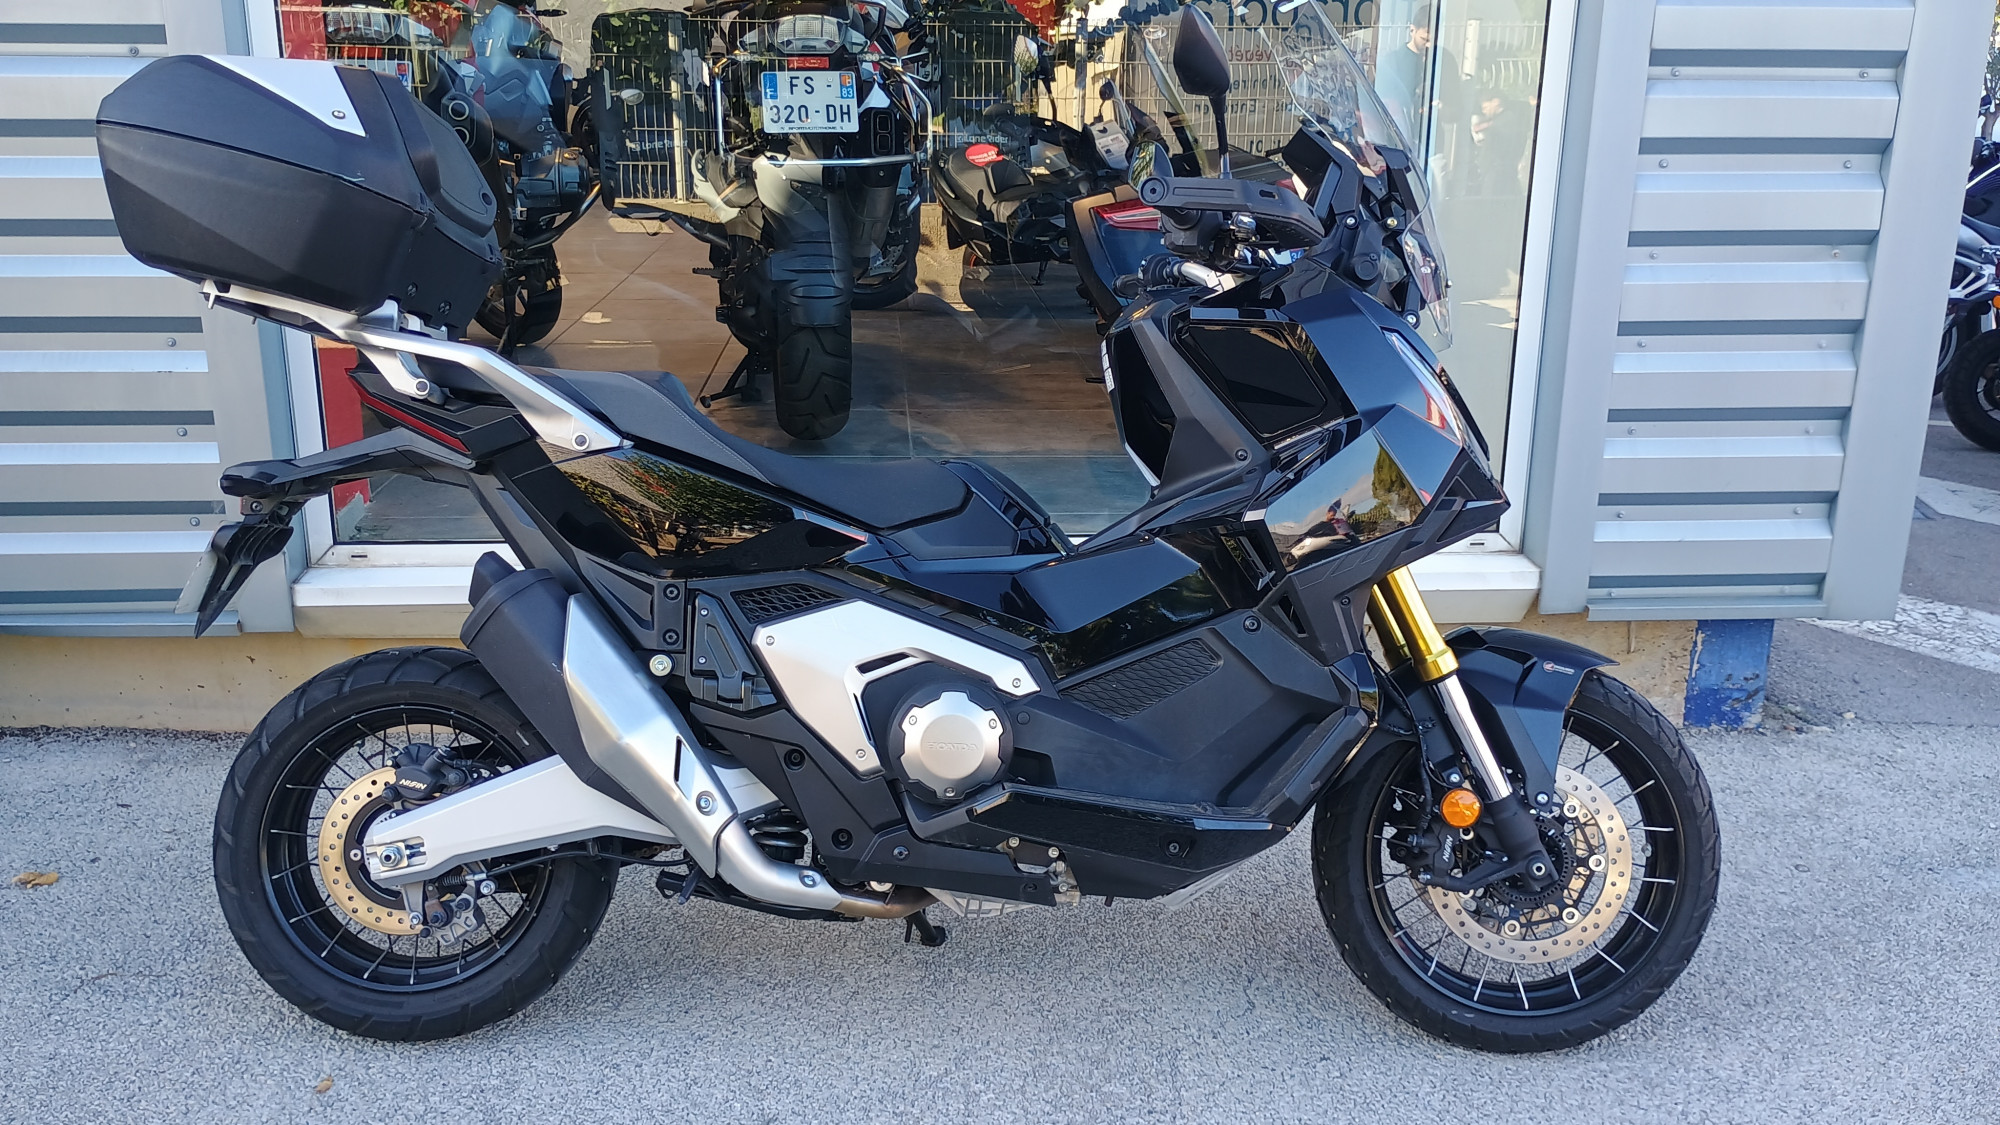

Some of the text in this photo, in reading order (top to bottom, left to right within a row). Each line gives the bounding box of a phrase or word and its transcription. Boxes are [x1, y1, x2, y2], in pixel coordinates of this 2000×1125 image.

[789, 76, 815, 95] FS
[766, 88, 775, 99] F
[842, 87, 853, 98] 83
[986, 134, 1008, 144] Rider
[927, 741, 978, 751] HONDA
[399, 778, 427, 790] NISSIN
